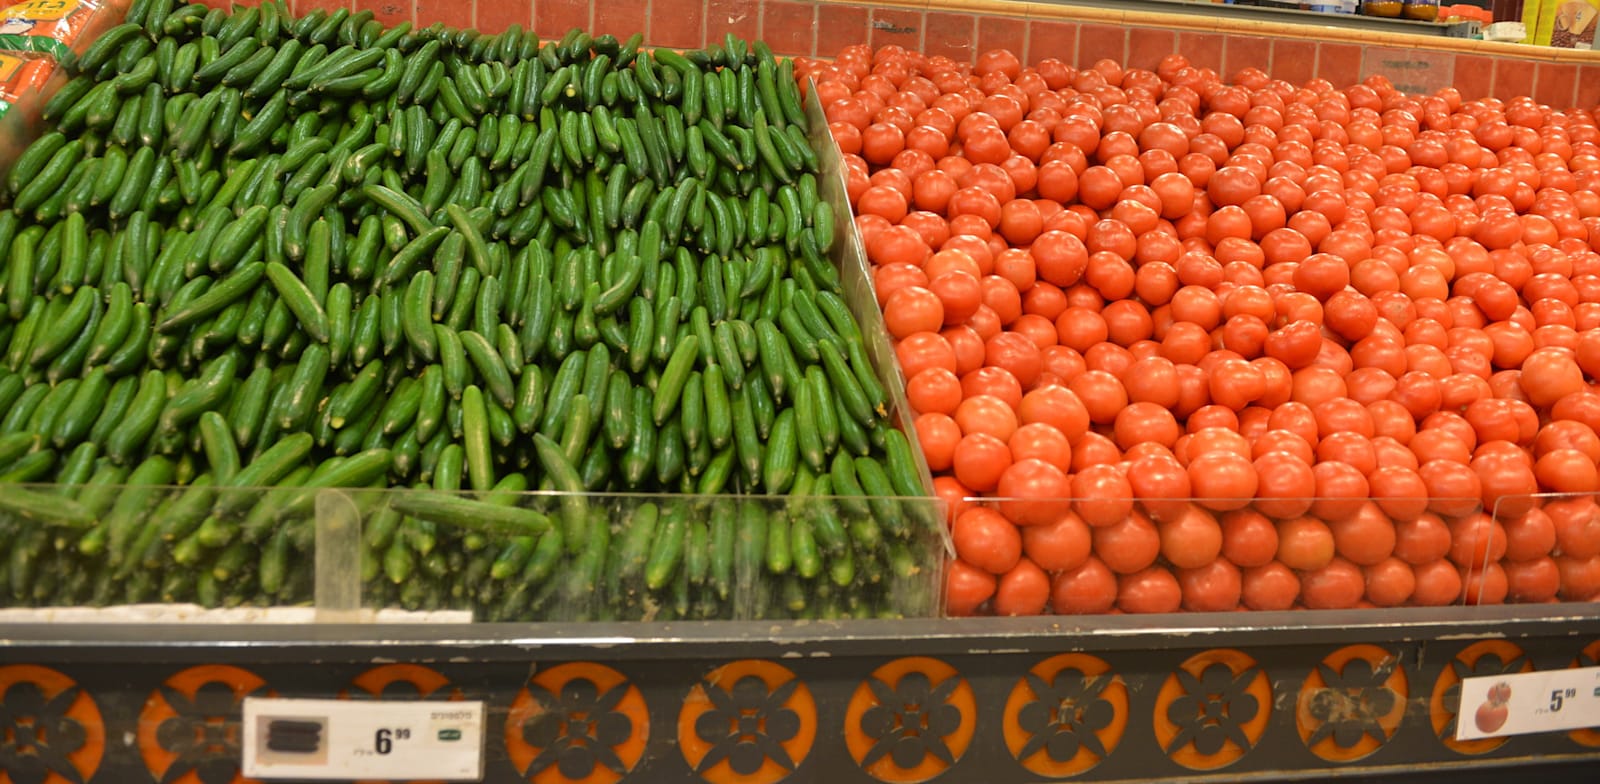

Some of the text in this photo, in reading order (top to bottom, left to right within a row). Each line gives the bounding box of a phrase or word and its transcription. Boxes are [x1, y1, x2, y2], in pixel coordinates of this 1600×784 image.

[1550, 690, 1563, 712] 5
[1565, 688, 1576, 698] 99
[375, 728, 392, 754] 6
[394, 728, 410, 740] 99
